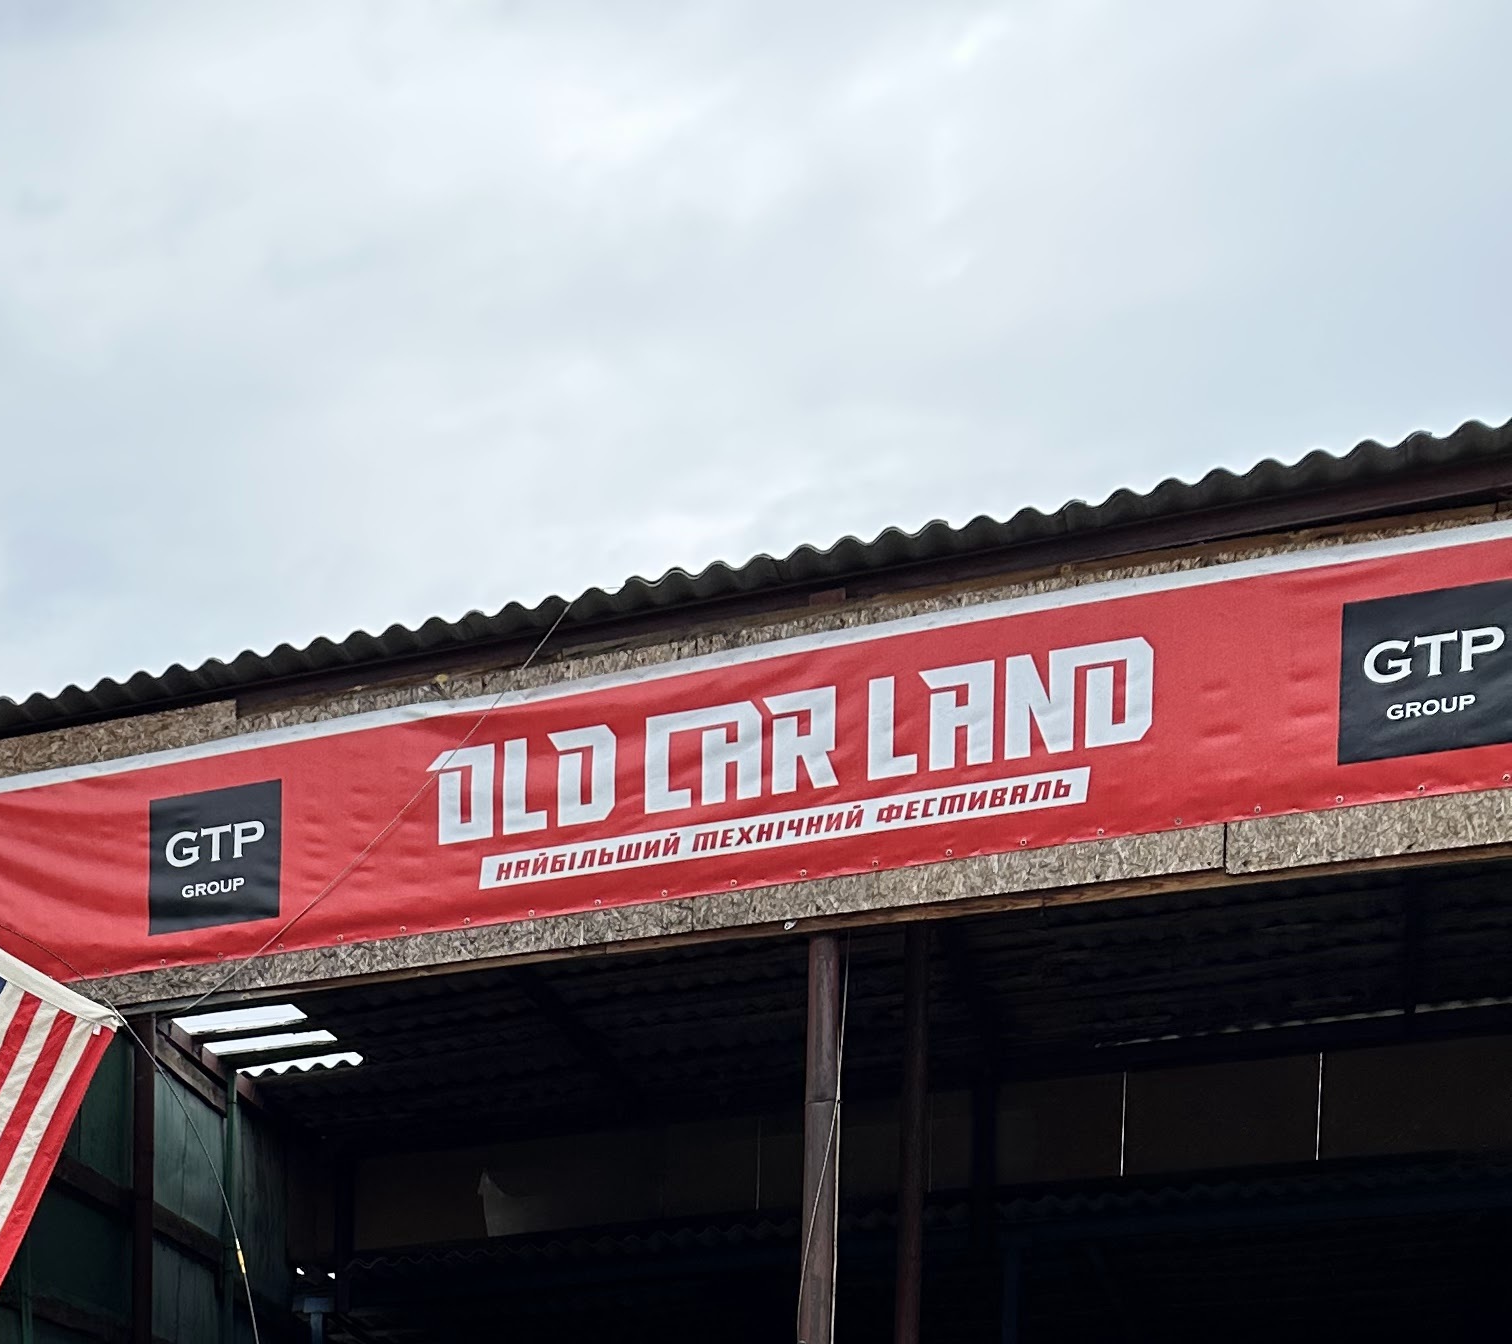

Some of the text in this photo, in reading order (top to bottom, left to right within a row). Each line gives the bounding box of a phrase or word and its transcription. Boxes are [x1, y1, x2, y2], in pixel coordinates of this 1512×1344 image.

[1363, 626, 1505, 684] GTP
[1386, 694, 1476, 720] GROUP
[426, 636, 1154, 845] OLD CAR LAND
[165, 820, 265, 868] GTP
[496, 778, 1072, 881] НАЙБІЛЬШИЙ ТЕХНІЧНИЙ ФЕСТИВАЛЬ
[182, 877, 245, 898] GROUP
